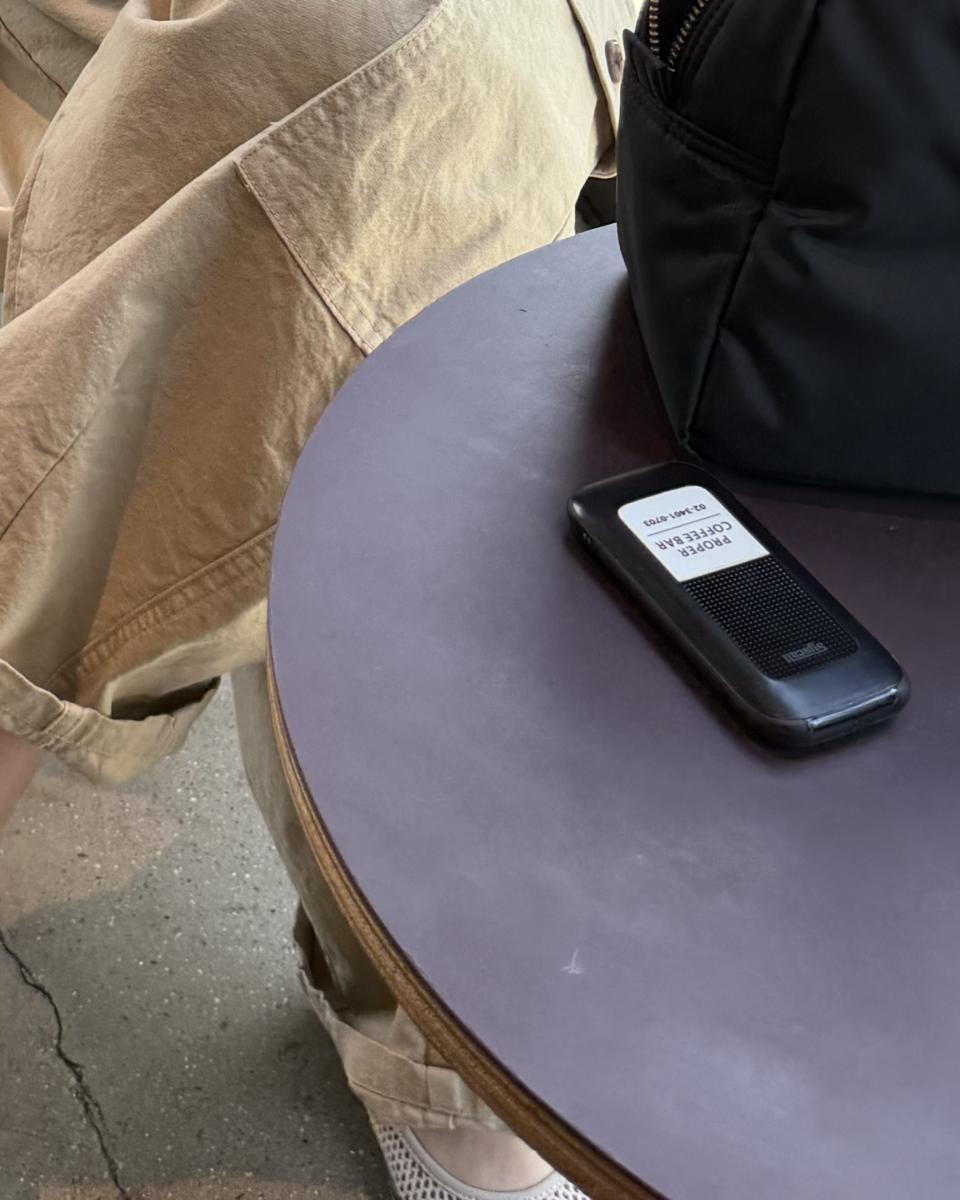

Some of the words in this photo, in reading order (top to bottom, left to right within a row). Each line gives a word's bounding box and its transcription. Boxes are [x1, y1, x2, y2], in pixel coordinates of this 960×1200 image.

[682, 521, 733, 541] COFFEE
[655, 535, 685, 551] BAR
[677, 535, 733, 558] PROPER
